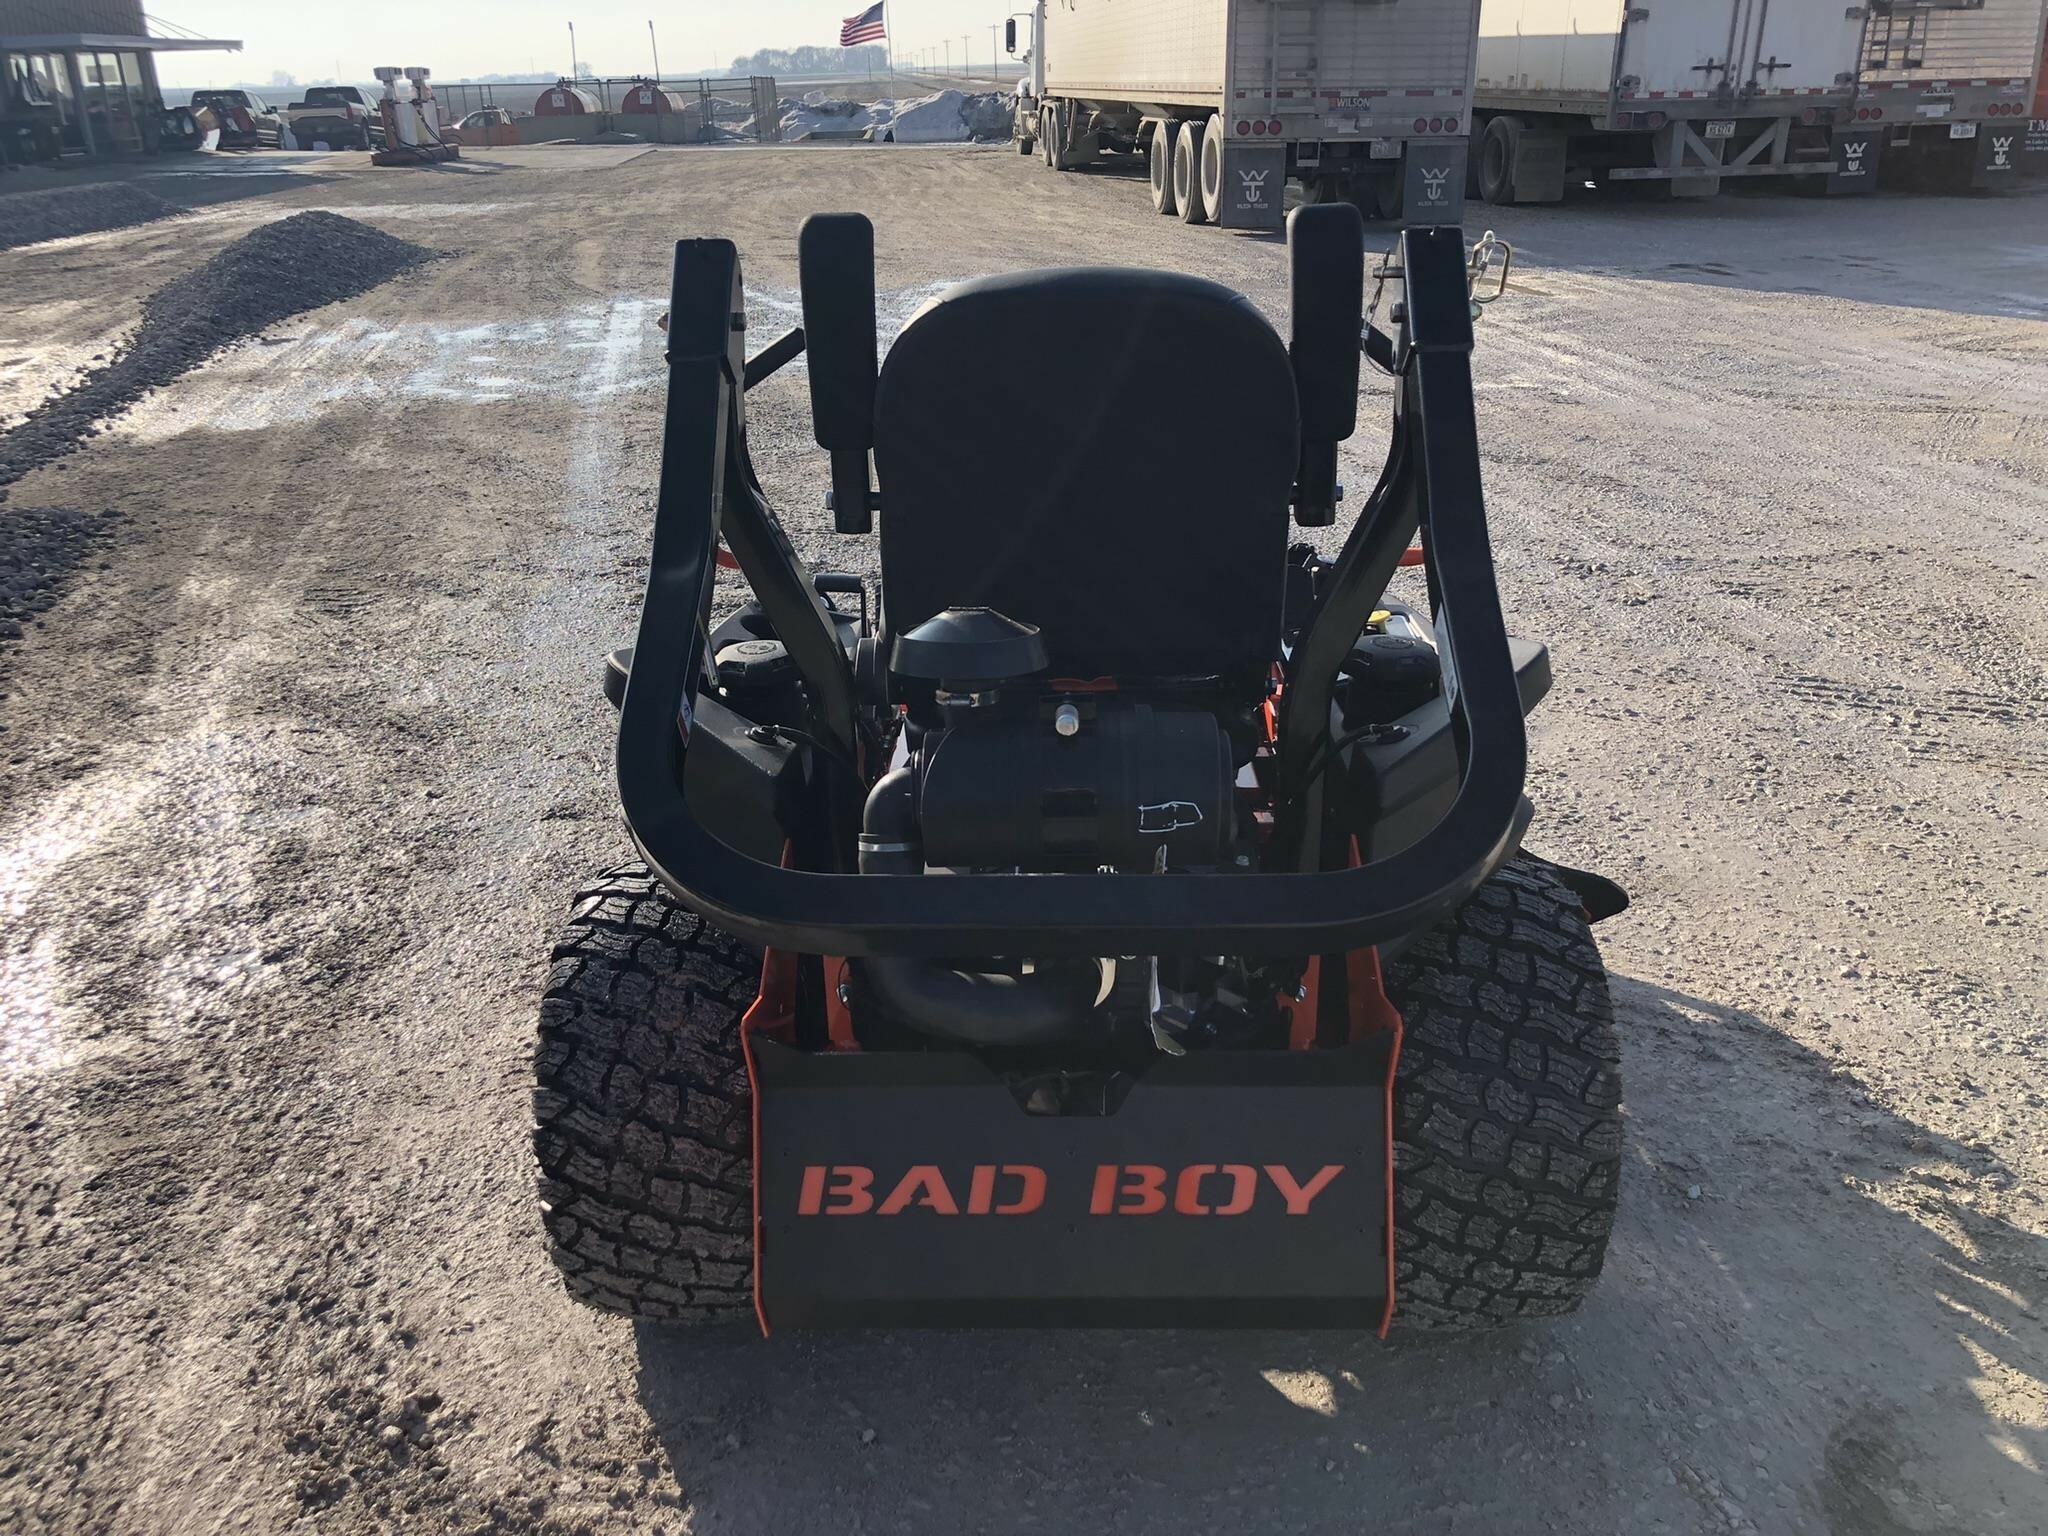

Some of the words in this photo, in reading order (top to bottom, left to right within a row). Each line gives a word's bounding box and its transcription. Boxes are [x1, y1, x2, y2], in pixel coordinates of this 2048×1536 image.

[1337, 97, 1370, 107] WILSON
[798, 1165, 1048, 1216] BAD
[1089, 1165, 1345, 1216] BOY
